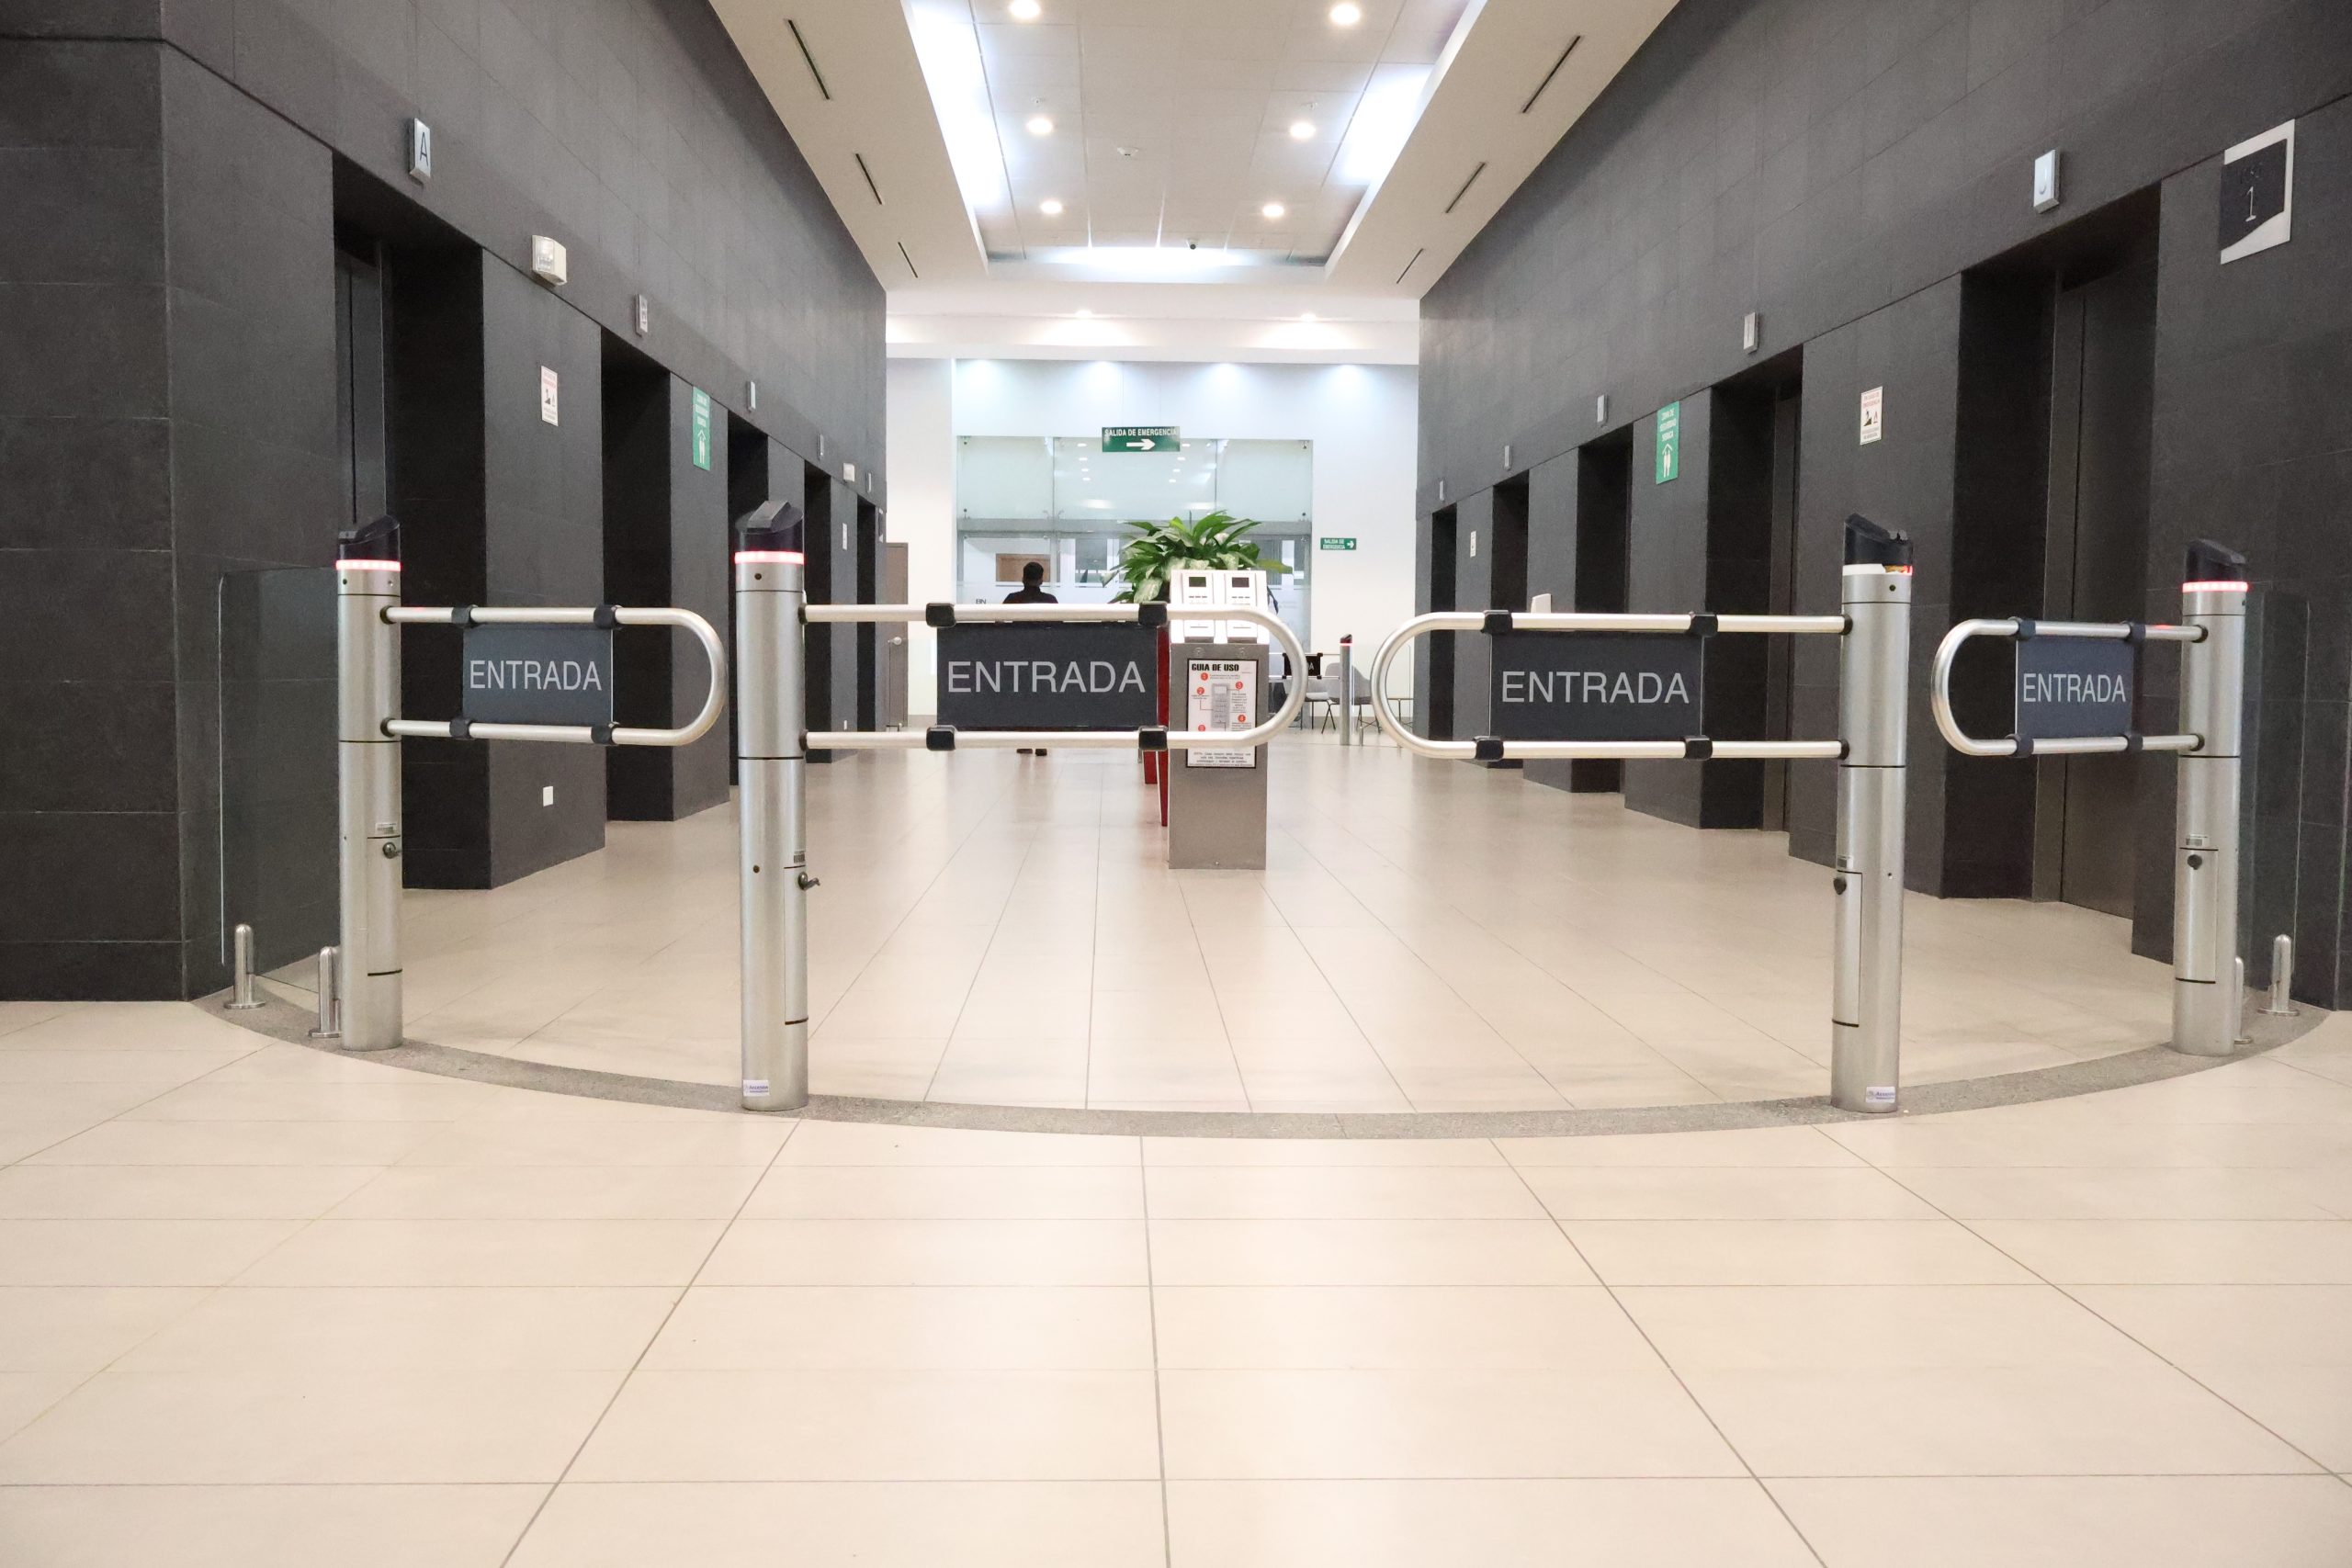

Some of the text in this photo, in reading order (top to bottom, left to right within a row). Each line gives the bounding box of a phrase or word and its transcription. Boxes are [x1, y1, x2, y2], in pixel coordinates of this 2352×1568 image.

[420, 131, 429, 167] A
[2245, 186, 2257, 222] 1
[1104, 427, 1177, 436] SALIDA DE EMERGENCIA
[469, 660, 603, 691] ENTRADA
[947, 660, 1146, 693] ENTRADA
[1501, 671, 1690, 704] ENTRADA
[2023, 672, 2127, 703] ENTRADA
